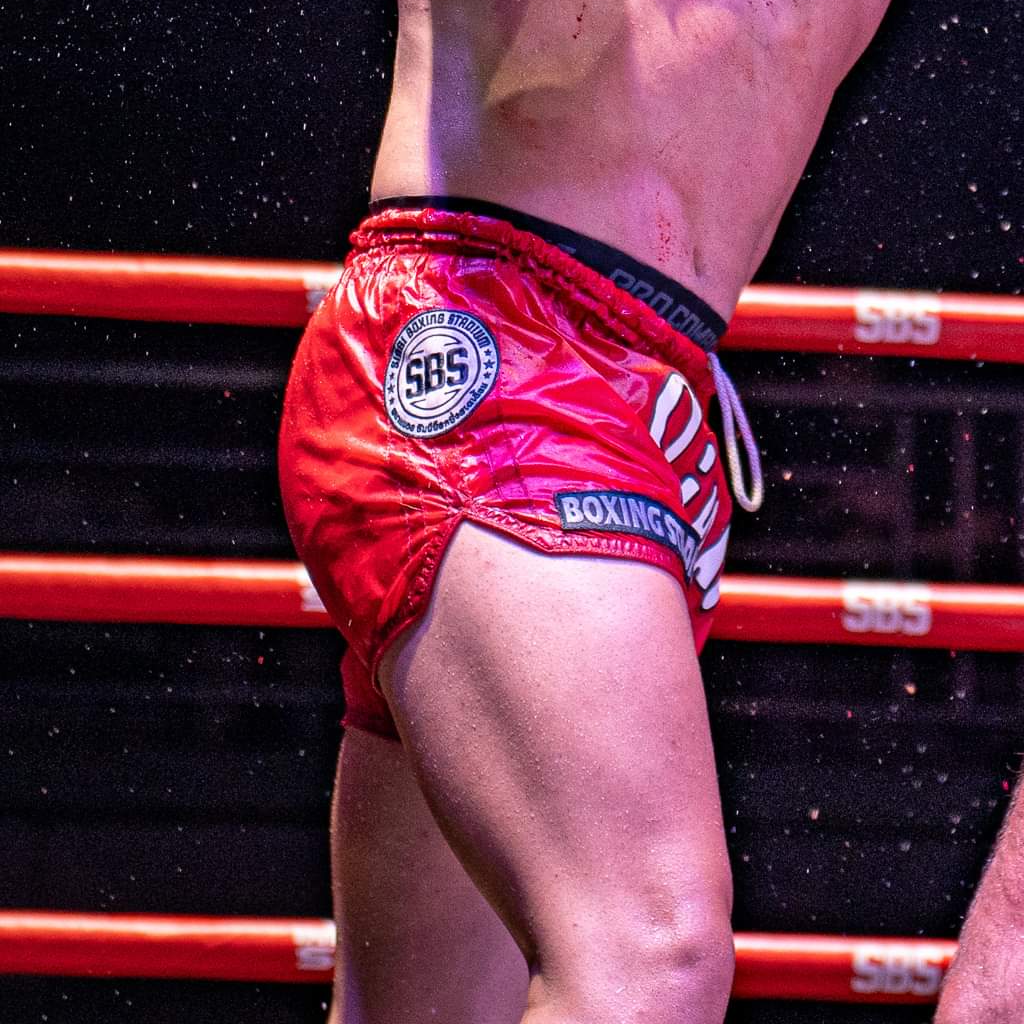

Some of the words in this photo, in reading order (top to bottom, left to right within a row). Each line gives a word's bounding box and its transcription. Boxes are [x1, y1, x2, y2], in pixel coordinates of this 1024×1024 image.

[405, 313, 445, 339] BOXING
[447, 313, 491, 349] STADIUM
[855, 288, 940, 344] SBS
[405, 347, 469, 399] SBS
[560, 495, 664, 537] BOXING
[841, 582, 931, 635] SBS
[851, 943, 942, 995] SBS
